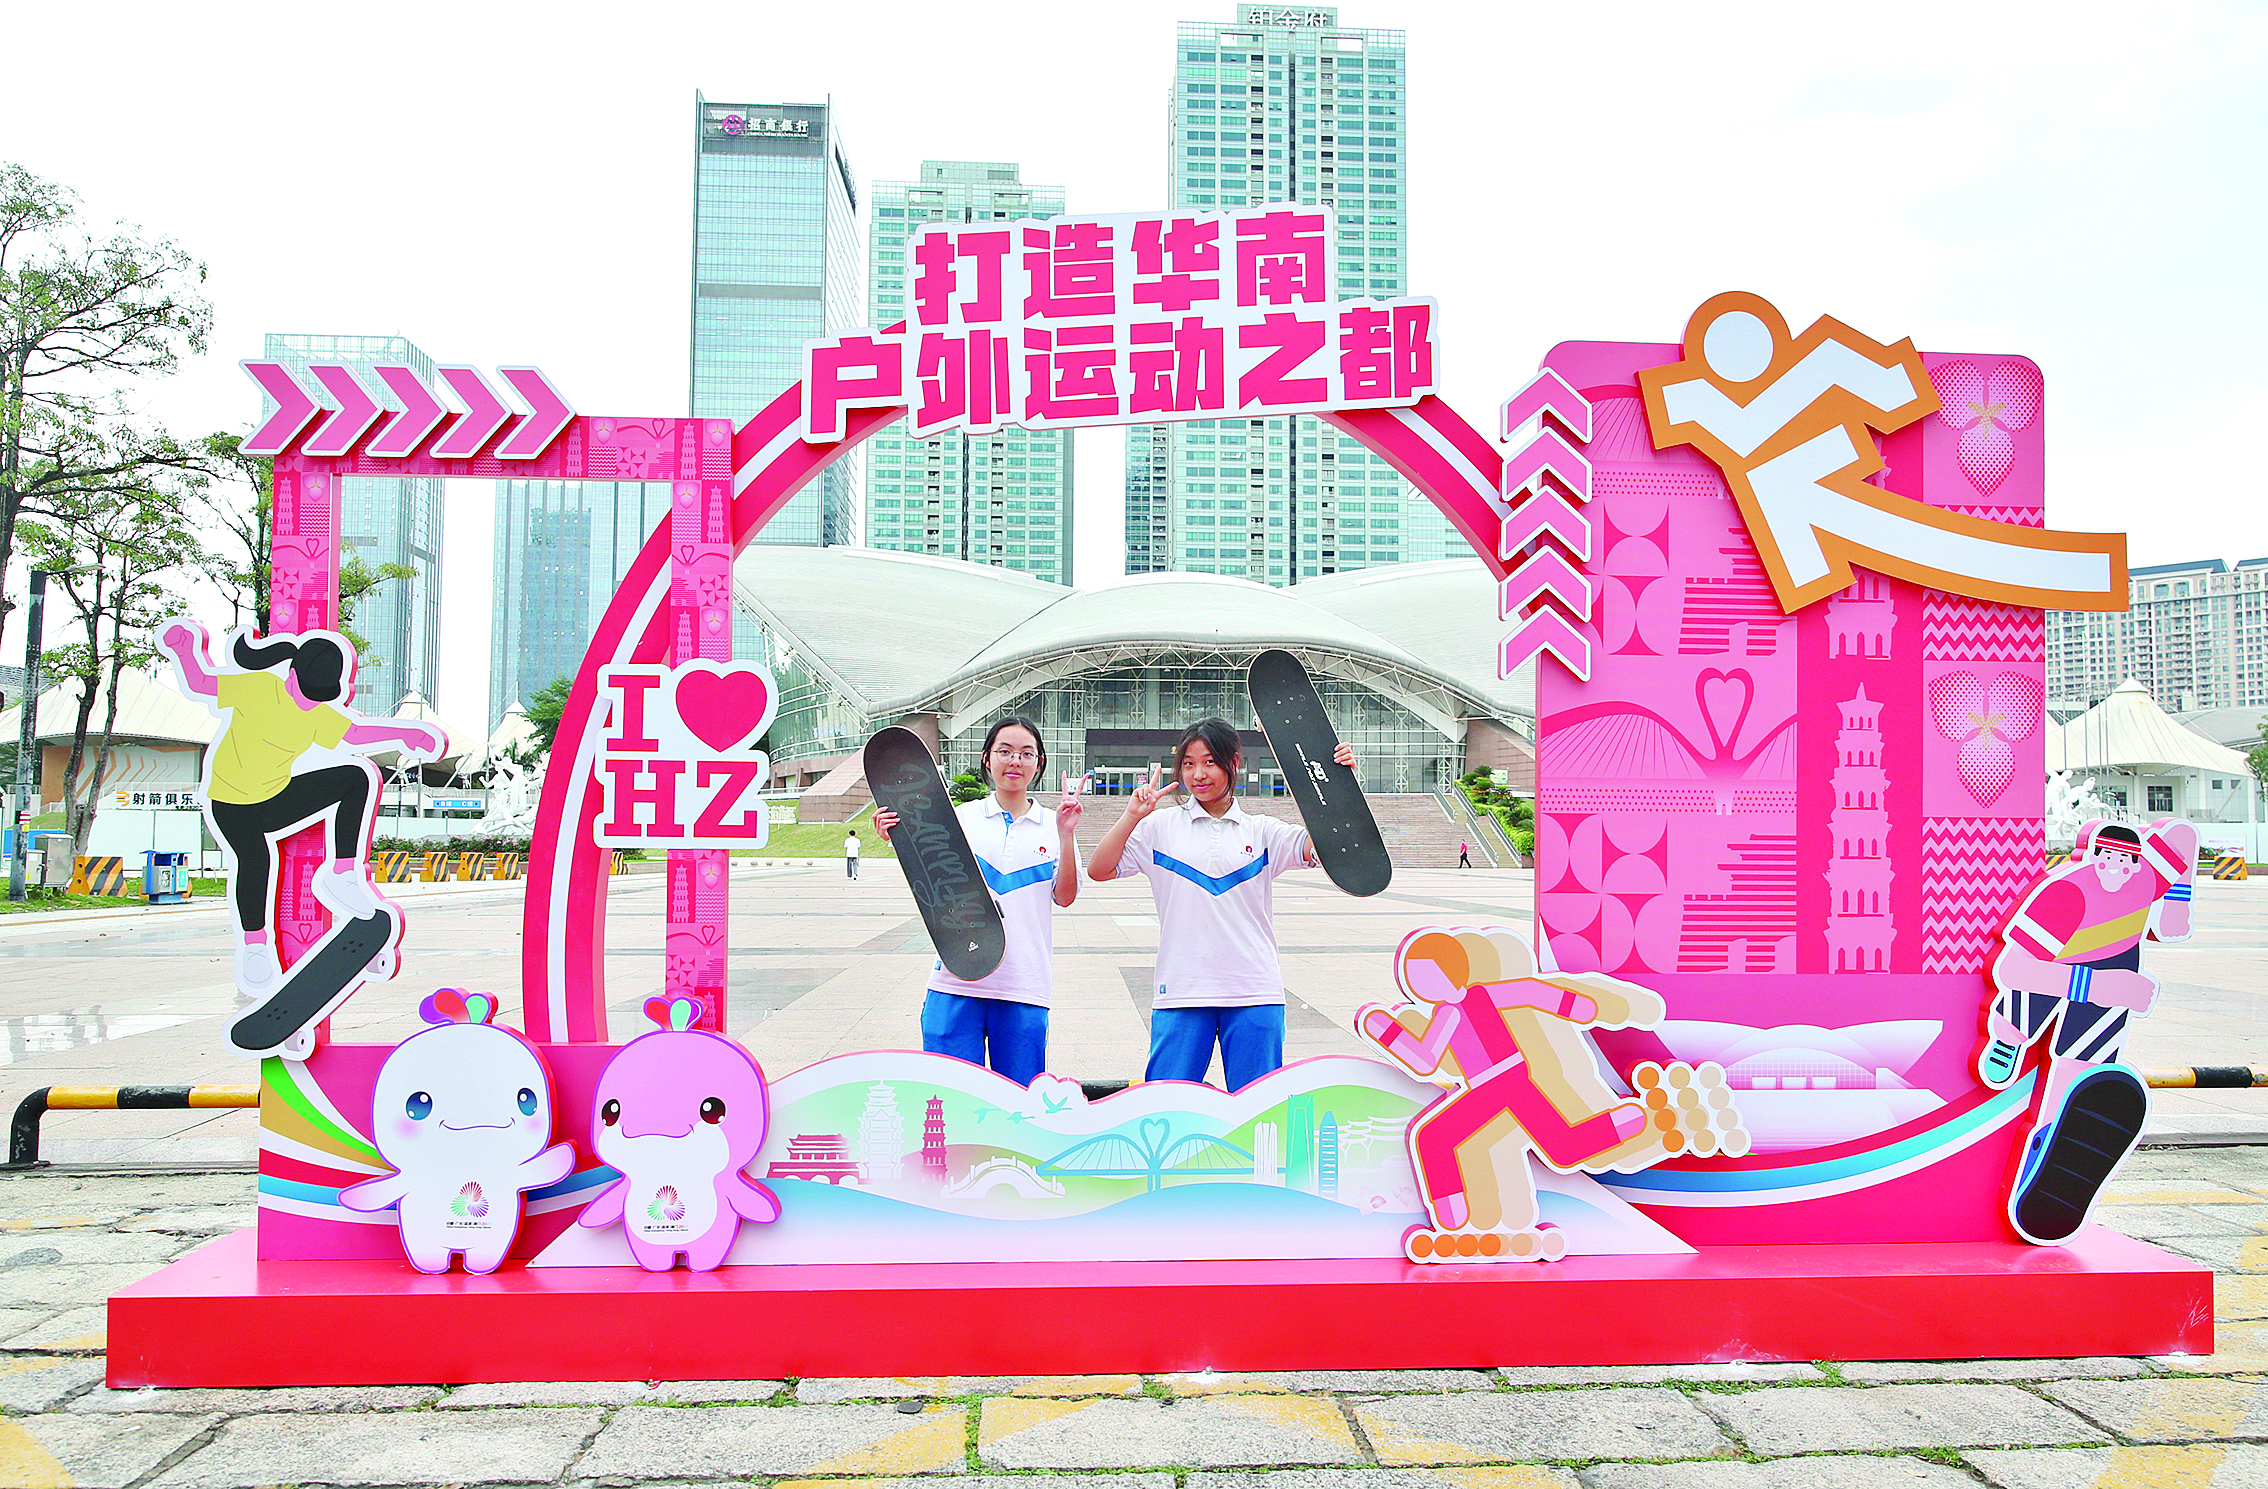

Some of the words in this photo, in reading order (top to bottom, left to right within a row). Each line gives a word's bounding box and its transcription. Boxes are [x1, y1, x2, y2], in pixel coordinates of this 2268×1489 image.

[1247, 5, 1328, 31] 铂金府
[747, 117, 809, 132] 招商银行
[914, 210, 1325, 326] 打造华南
[809, 303, 1434, 434] 户外运动之都
[606, 674, 660, 752] I
[133, 792, 200, 805] 射箭俱乐
[603, 759, 758, 838] HZ
